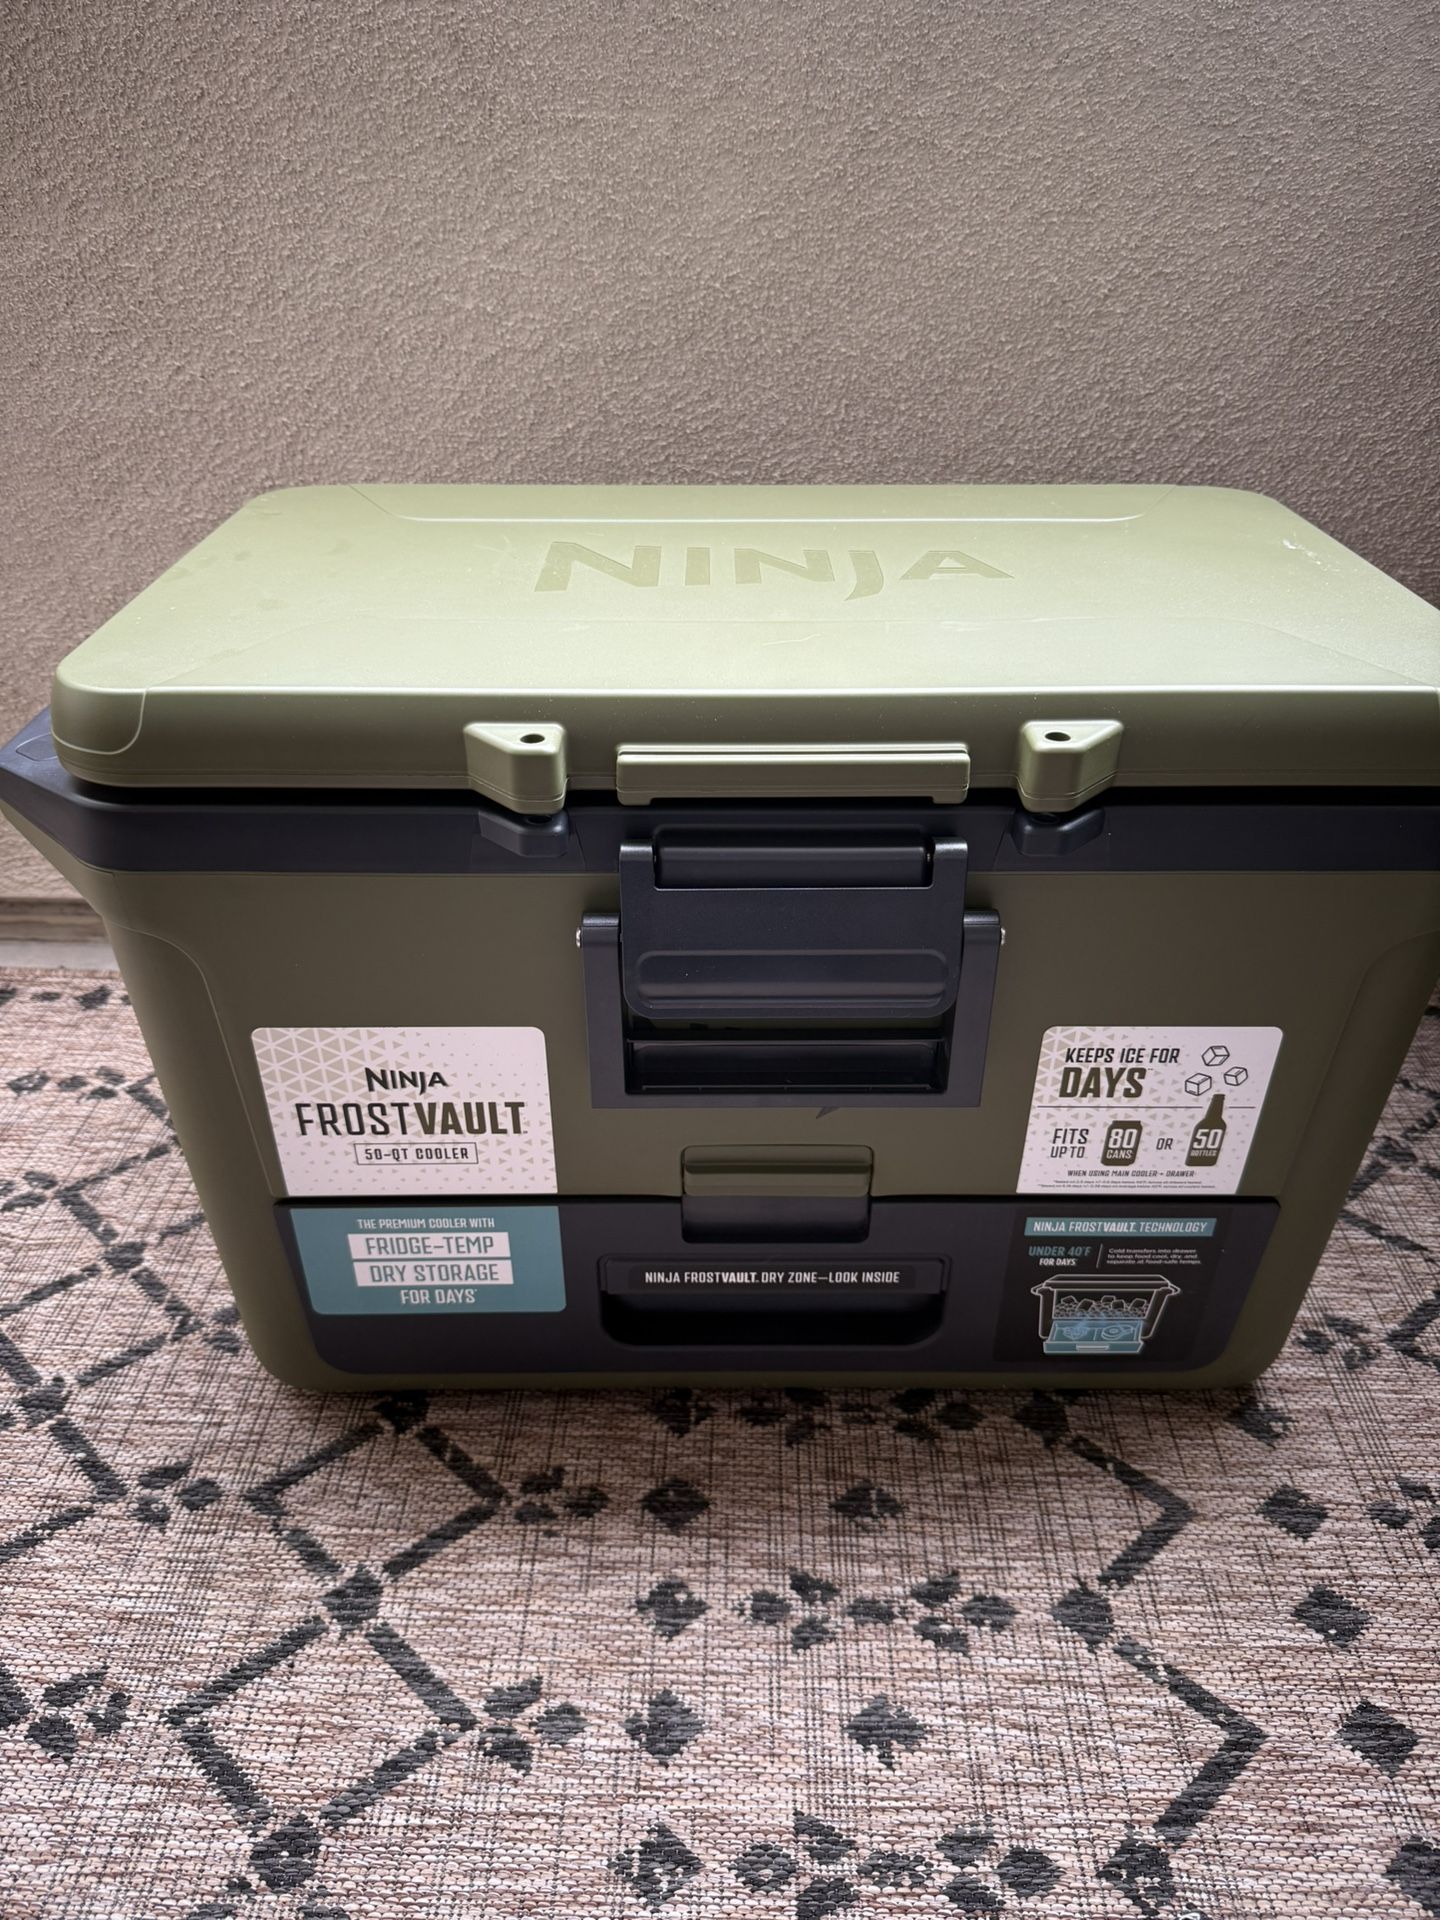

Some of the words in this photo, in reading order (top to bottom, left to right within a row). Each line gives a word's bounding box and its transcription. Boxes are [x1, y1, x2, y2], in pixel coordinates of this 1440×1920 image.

[534, 541, 1014, 601] NINJA
[1065, 1048, 1115, 1063] KEEPS
[1119, 1048, 1144, 1063] ICE
[1149, 1048, 1180, 1063] FOR
[365, 1067, 449, 1095] NINJA
[295, 1102, 526, 1136] FROSTVAULT
[1052, 1128, 1090, 1144] FITS
[1108, 1128, 1138, 1149] 80
[1193, 1129, 1223, 1149] 50
[1156, 1138, 1174, 1151] OR
[365, 1148, 409, 1161] 50-QT
[416, 1147, 470, 1160] COOLER
[1106, 1149, 1133, 1159] CANS
[357, 1219, 377, 1230] THE
[379, 1218, 426, 1229] PREMIUM
[429, 1218, 467, 1229] COOLER
[469, 1217, 496, 1228] WITH
[1033, 1221, 1066, 1232] NINJA
[1068, 1221, 1136, 1232] FROSTVAULT
[1139, 1222, 1208, 1233] TECHNOLOGY
[365, 1236, 494, 1255] FRIDGE-TEMP
[1028, 1246, 1065, 1257] UNDER
[1039, 1258, 1055, 1266] FOR
[369, 1265, 406, 1283] DRY
[414, 1264, 500, 1282] STORAGE
[645, 1271, 681, 1283] NINJA
[684, 1271, 758, 1283] FROSTVAULT
[761, 1271, 785, 1283] DRY
[861, 1271, 900, 1284] INSIDE
[400, 1289, 430, 1304] FOR
